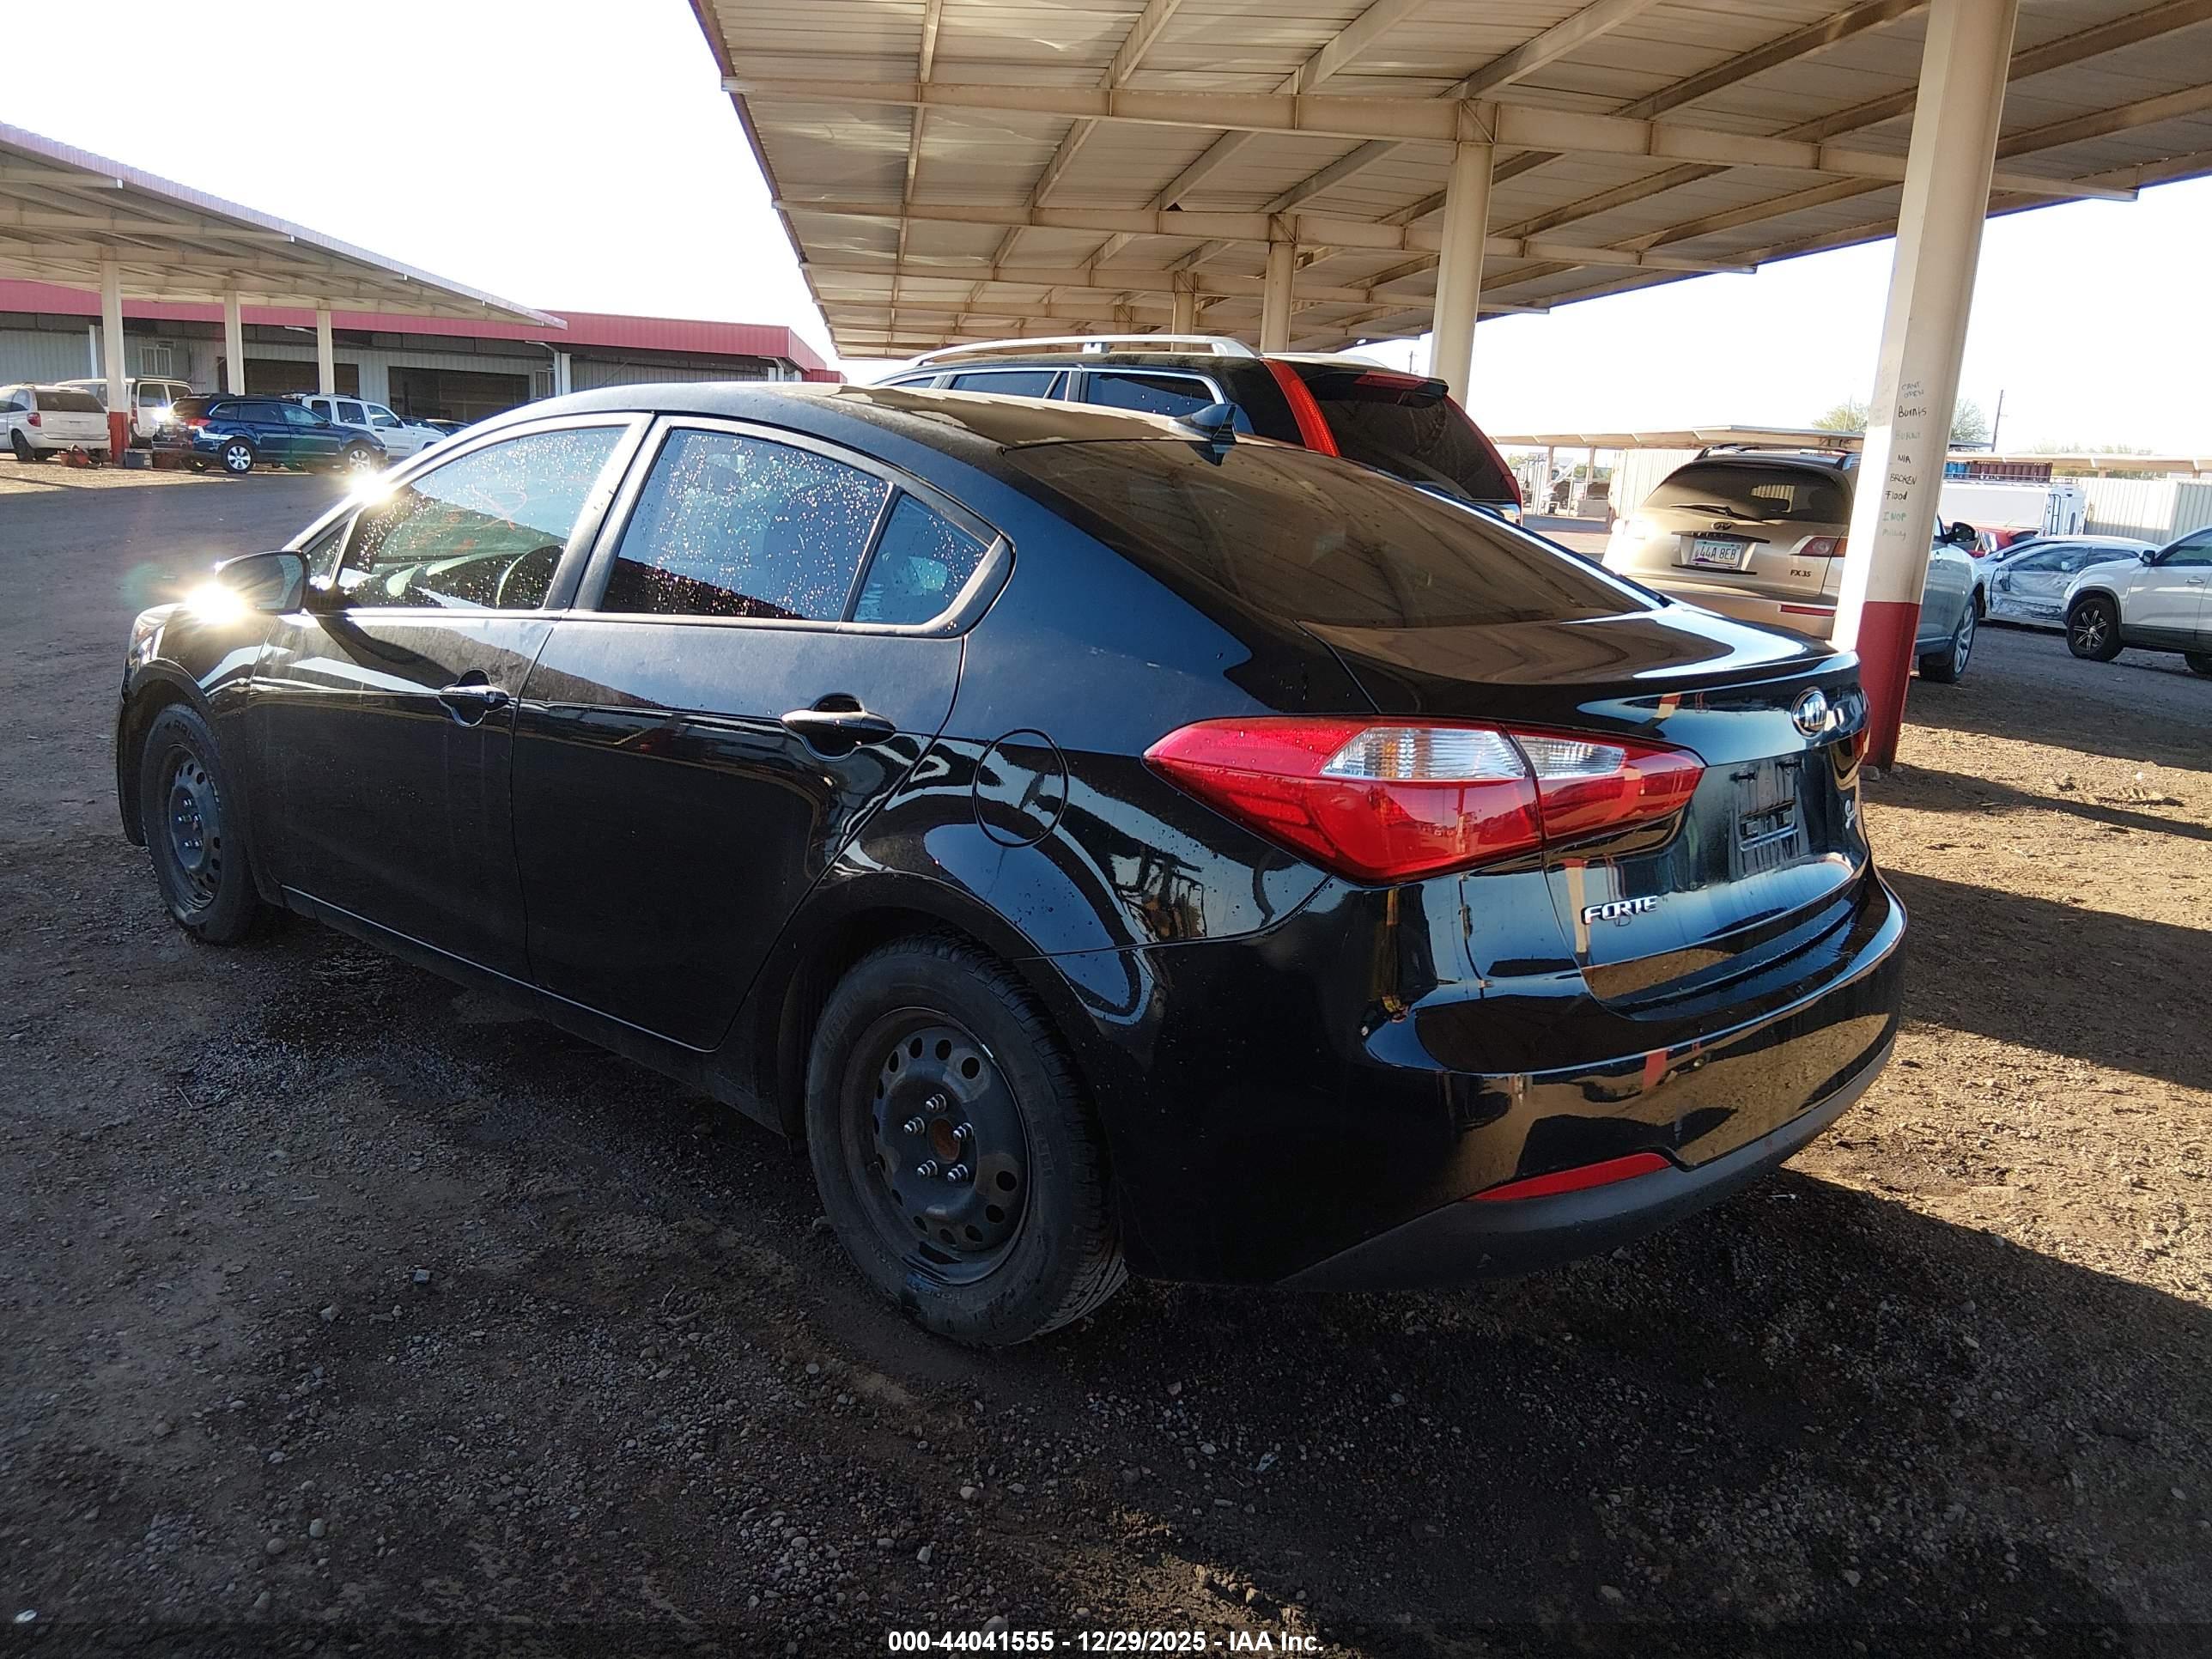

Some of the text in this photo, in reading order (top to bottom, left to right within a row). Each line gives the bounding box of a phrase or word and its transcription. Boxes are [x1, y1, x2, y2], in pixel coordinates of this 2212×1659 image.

[1890, 473, 1917, 485] BROKEN
[1884, 490, 1908, 501] Flood
[1583, 895, 1658, 925] FORTE
